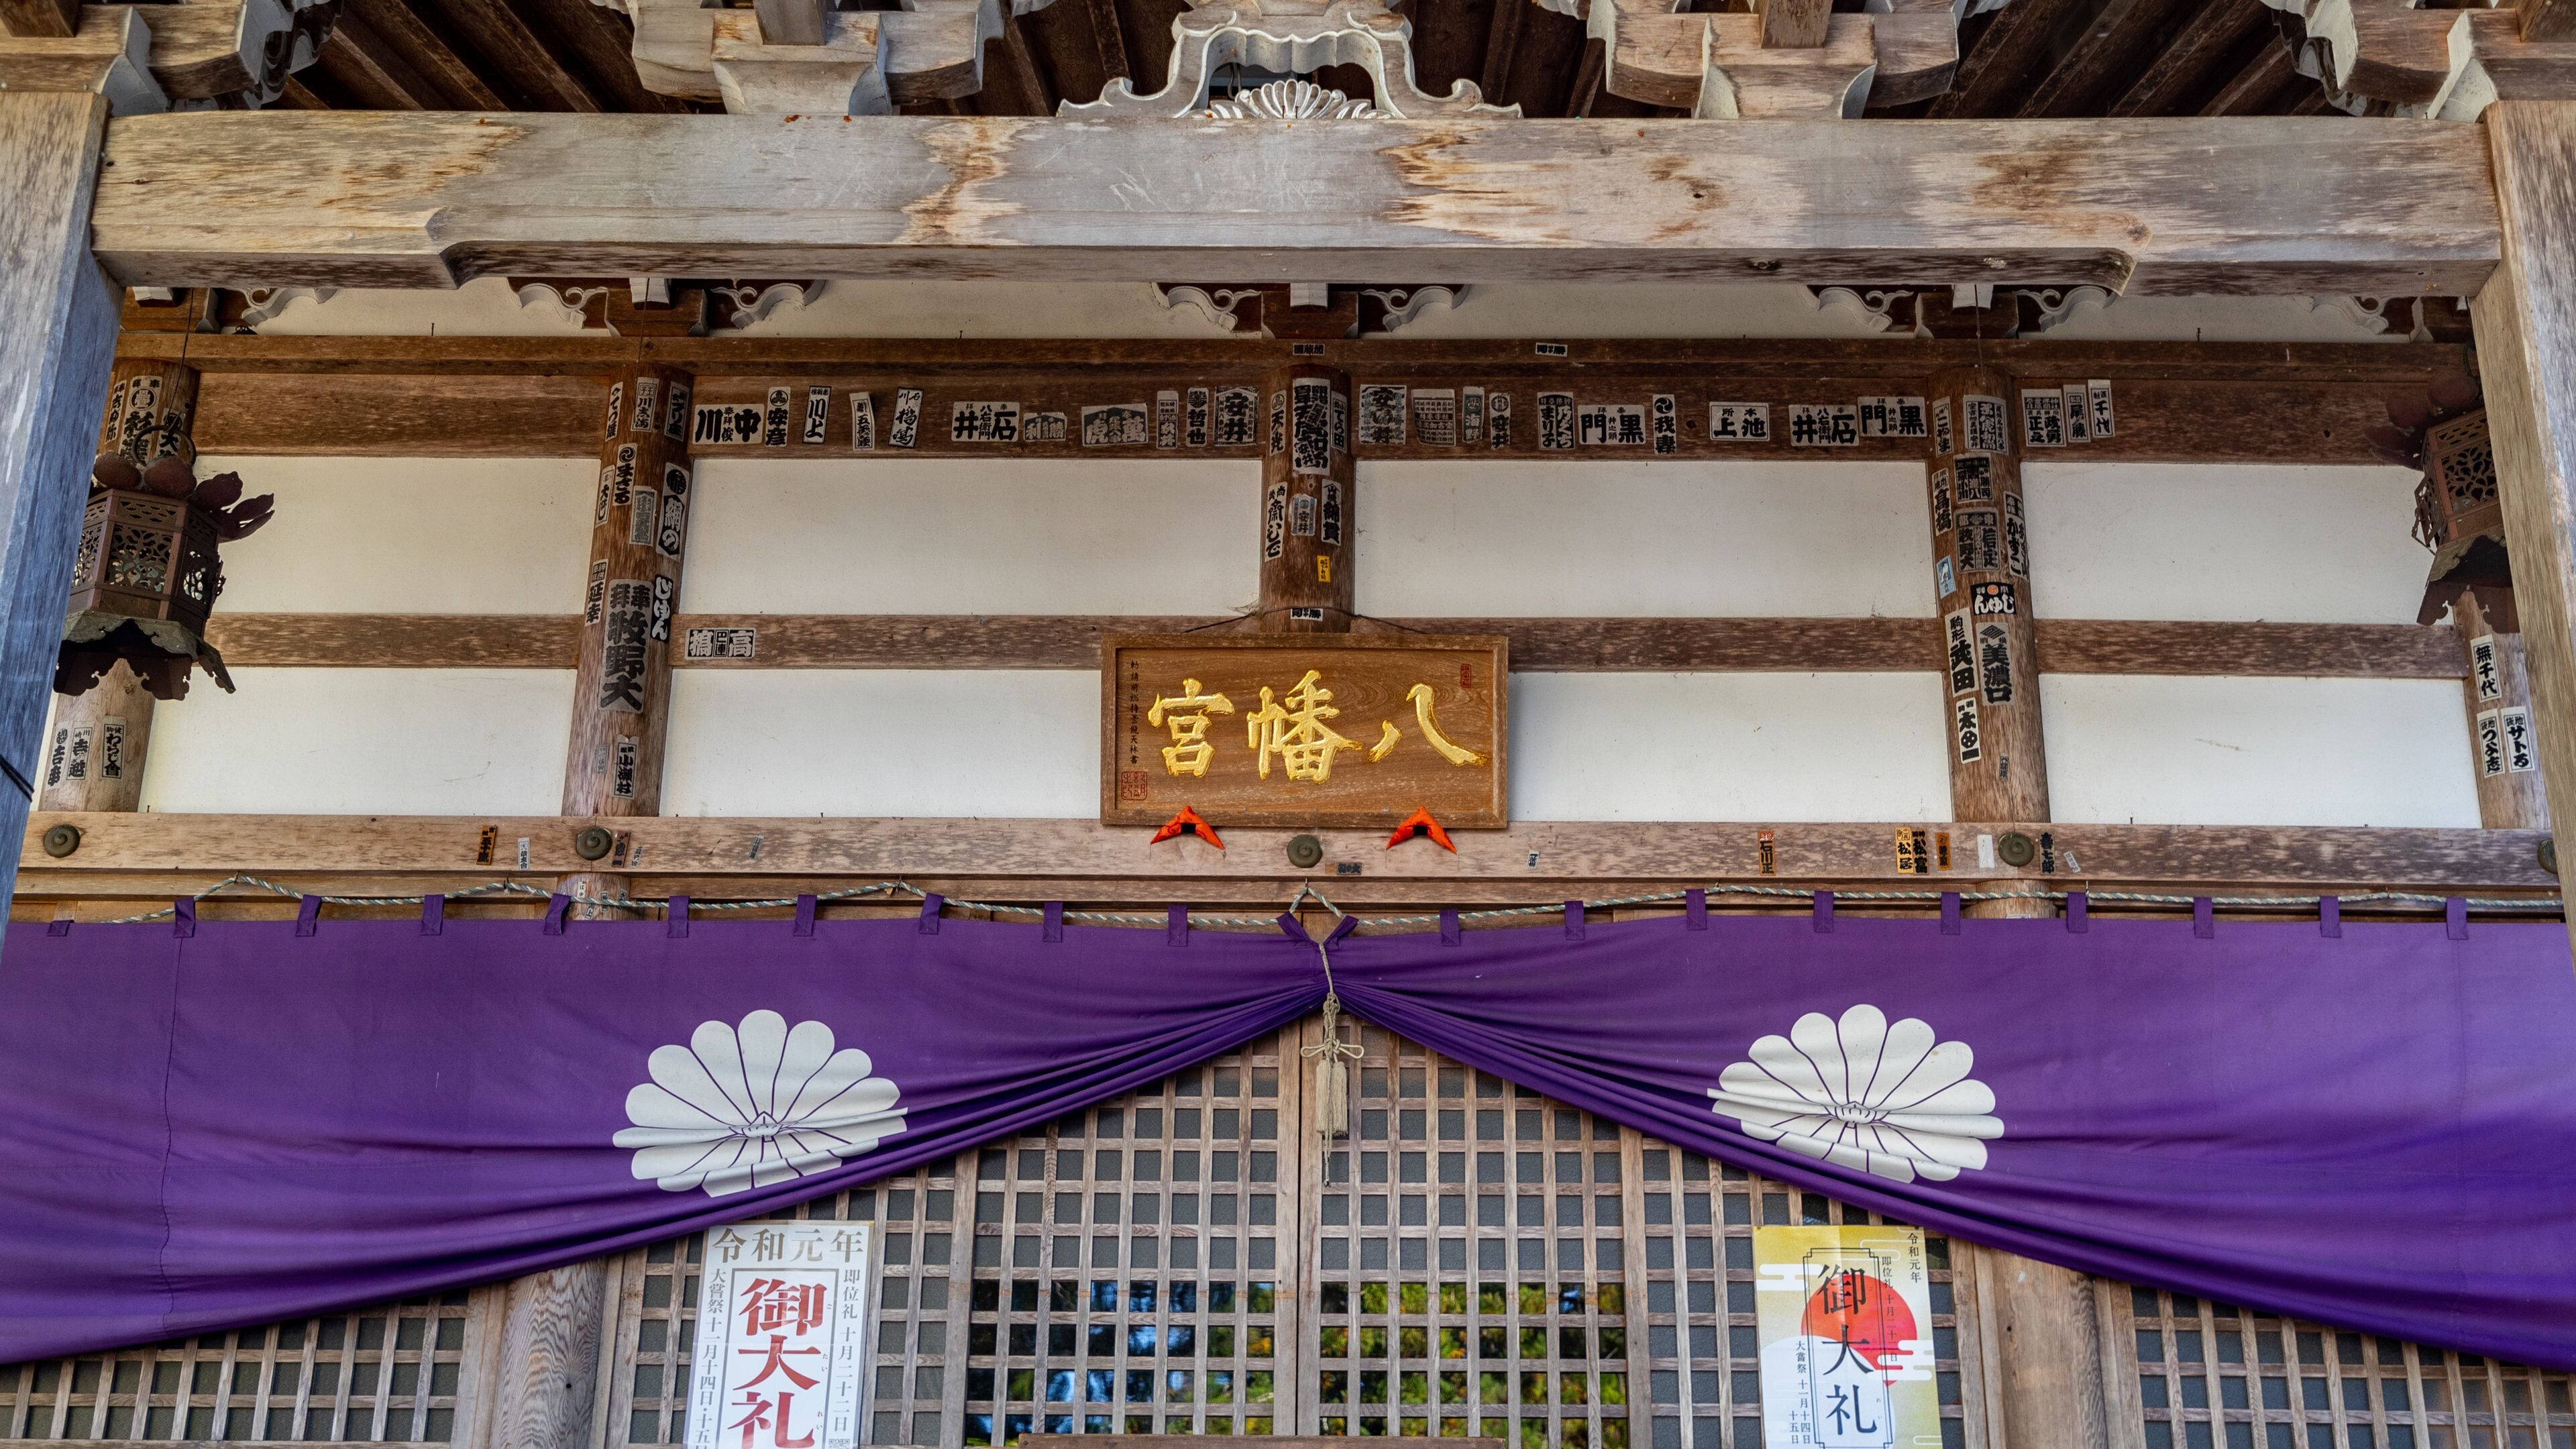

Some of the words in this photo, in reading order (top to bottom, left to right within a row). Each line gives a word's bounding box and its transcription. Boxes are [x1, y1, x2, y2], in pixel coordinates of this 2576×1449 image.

[806, 399, 826, 438] 川上
[979, 405, 992, 441] 八右衛門
[1186, 408, 1207, 446] 哲也
[1949, 640, 1975, 693] 武田
[2475, 645, 2498, 696] 無千代
[2508, 727, 2530, 767] サトる
[712, 1227, 864, 1263] 令和元年
[1907, 1232, 1921, 1283] 令和元年
[841, 1269, 861, 1320] 即位礼
[727, 1277, 827, 1449] 御大礼
[1817, 1264, 1878, 1436] 御大礼
